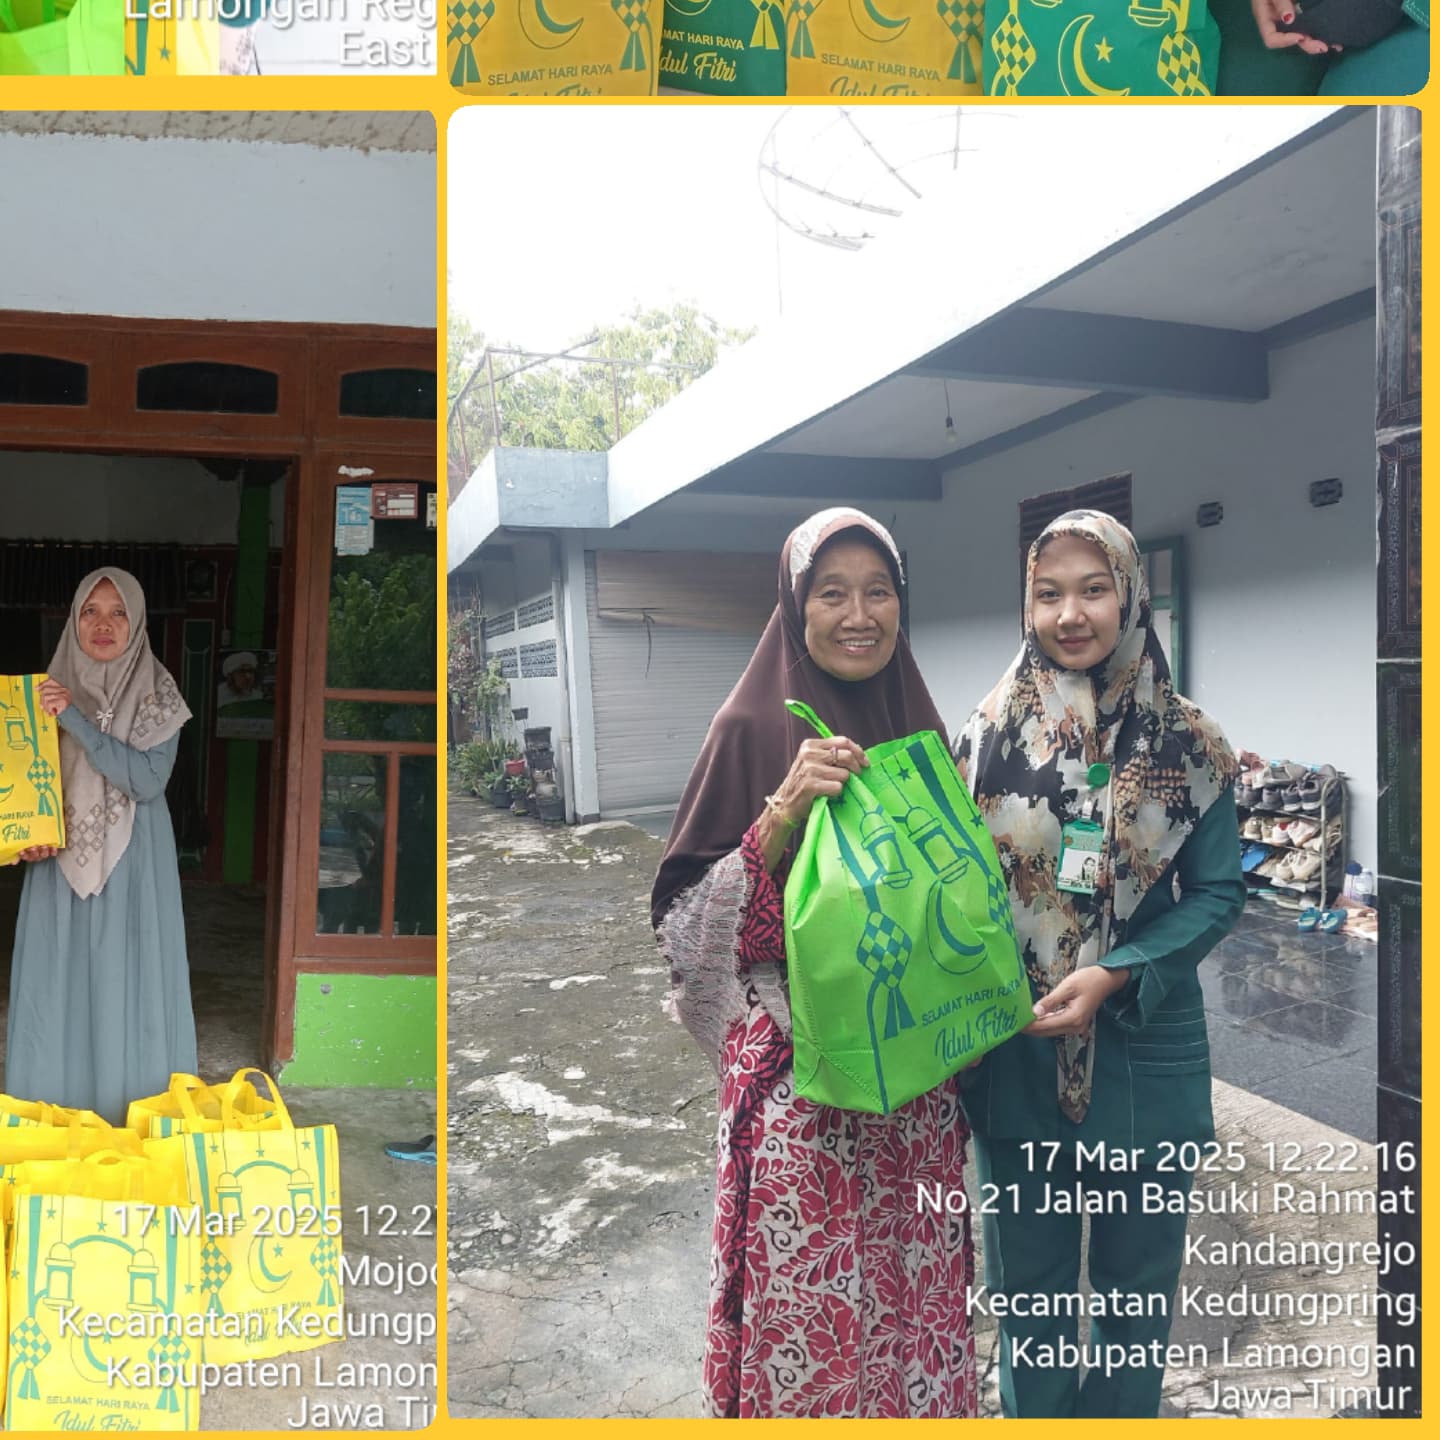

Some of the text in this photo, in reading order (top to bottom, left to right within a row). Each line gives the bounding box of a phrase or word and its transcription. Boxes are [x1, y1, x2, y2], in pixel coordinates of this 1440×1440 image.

[687, 32, 714, 46] HARI
[716, 35, 745, 50] RAYA
[488, 63, 613, 86] SELAMAT HARI RAYA
[660, 49, 737, 82] dul Fitri
[821, 52, 942, 82] SELAMAT HARI RAYA
[2, 823, 31, 844] Fitri
[965, 988, 994, 1006] HARI
[934, 1004, 1018, 1066] Idul Fitri
[46, 1395, 94, 1406] SELAMAT
[123, 1400, 150, 1411] RAYA
